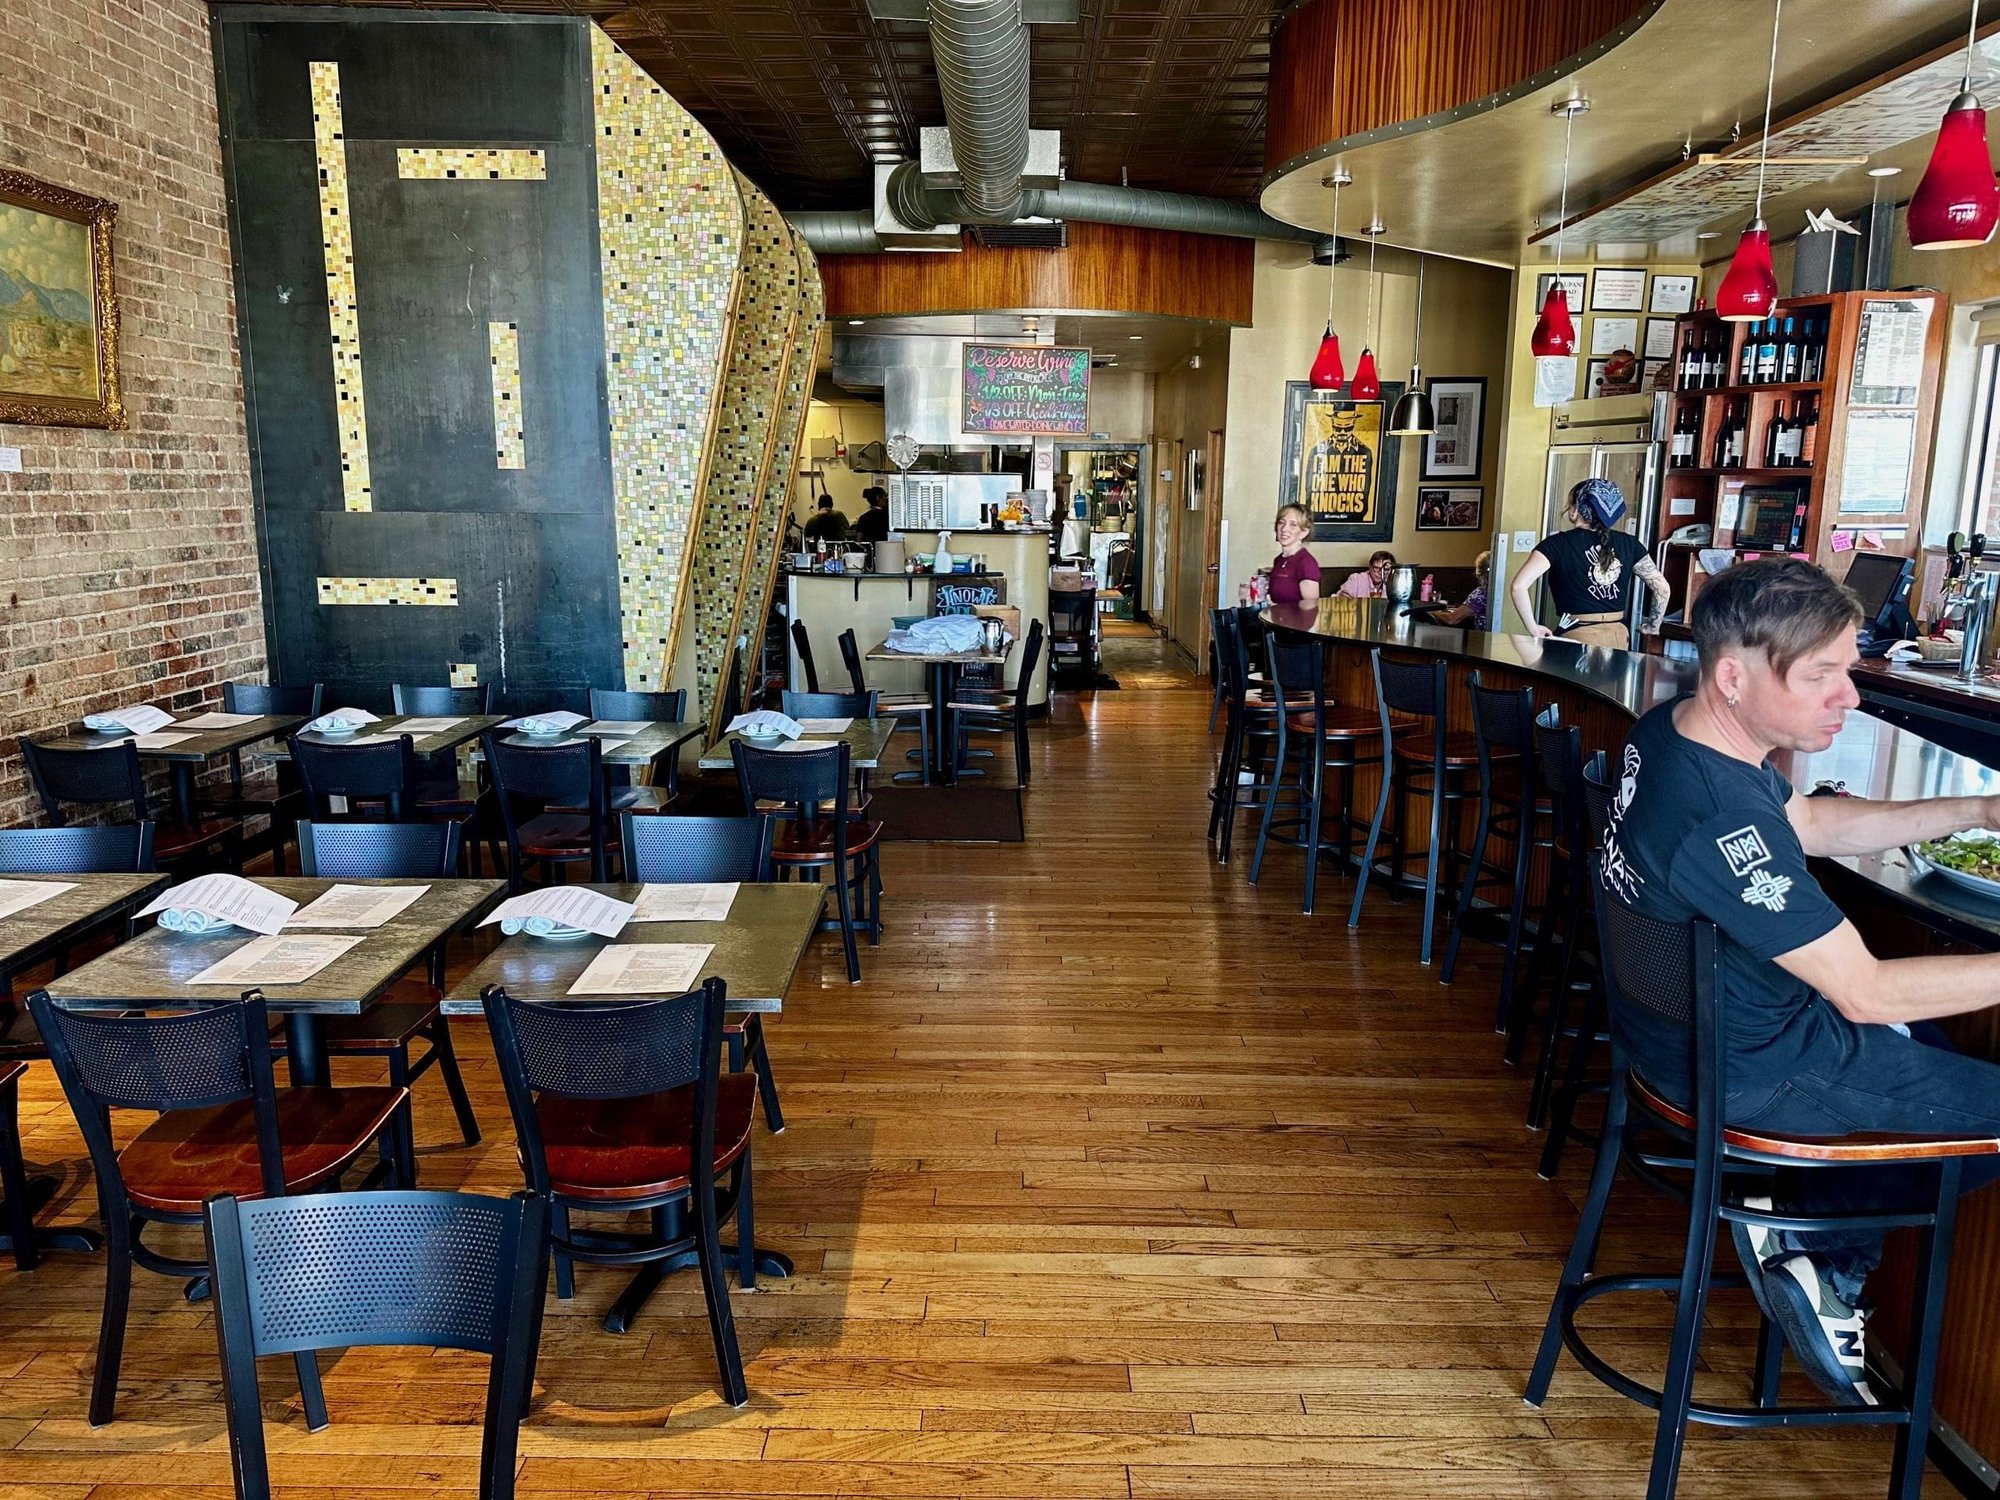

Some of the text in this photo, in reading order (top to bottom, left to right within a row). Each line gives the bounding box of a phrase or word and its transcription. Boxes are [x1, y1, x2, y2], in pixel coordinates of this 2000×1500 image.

[970, 347, 1077, 373] Reserve Wine
[982, 385, 1001, 400] 1/2
[1003, 385, 1025, 400] OFF
[983, 402, 1001, 418] 1/3
[1003, 402, 1025, 418] OFF
[1313, 454, 1368, 473] I AM THE
[1312, 473, 1366, 492] ONE WHO
[1311, 492, 1365, 513] KNOCKS
[952, 589, 983, 604] NOW
[1587, 583, 1620, 600] PIZZA
[1835, 1331, 1862, 1357] N
